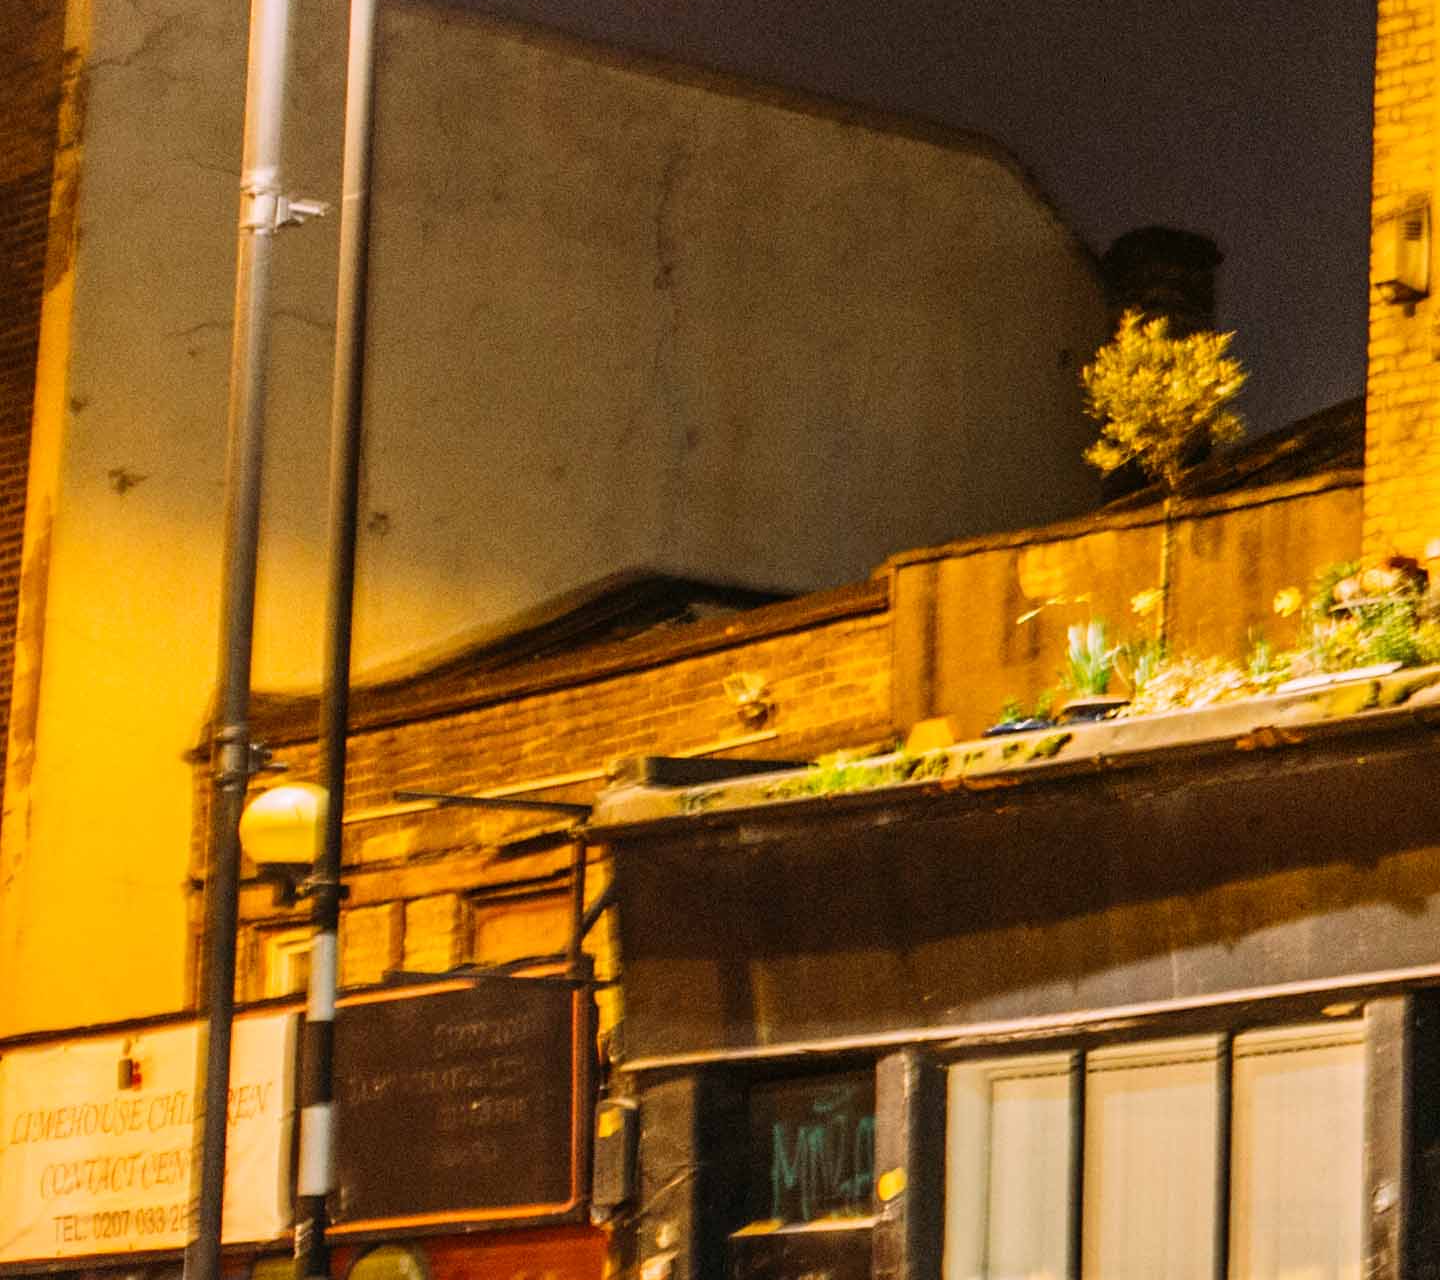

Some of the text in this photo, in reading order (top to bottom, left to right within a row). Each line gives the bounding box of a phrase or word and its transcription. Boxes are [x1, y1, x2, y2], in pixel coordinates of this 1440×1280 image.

[10, 1082, 273, 1145] LIMEHOUSE CHILEN
[40, 1152, 142, 1200] CONTACT
[92, 1209, 130, 1240] 0207
